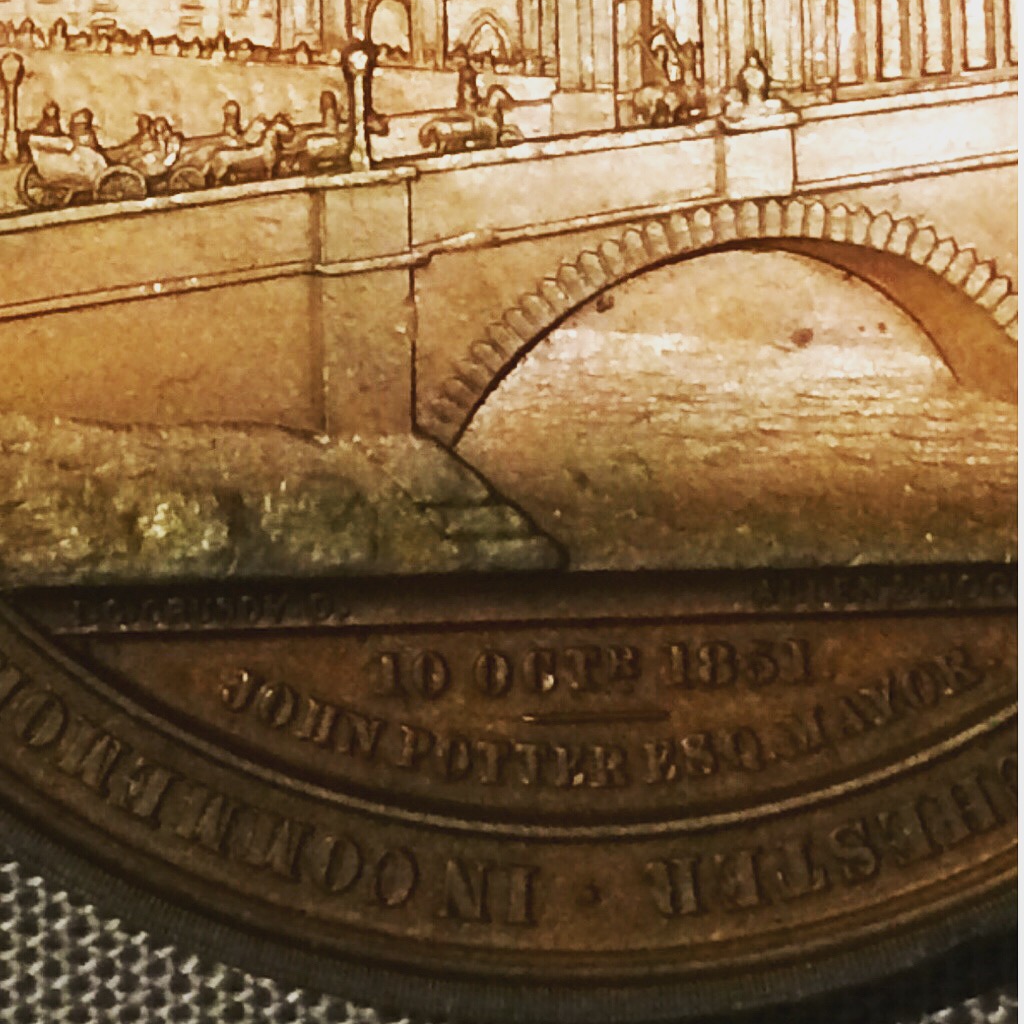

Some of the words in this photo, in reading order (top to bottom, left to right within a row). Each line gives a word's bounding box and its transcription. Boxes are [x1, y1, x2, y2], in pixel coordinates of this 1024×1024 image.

[370, 648, 450, 699] 10
[220, 666, 384, 759] JOHN
[395, 721, 631, 790] POTTER
[436, 856, 543, 926] IN
